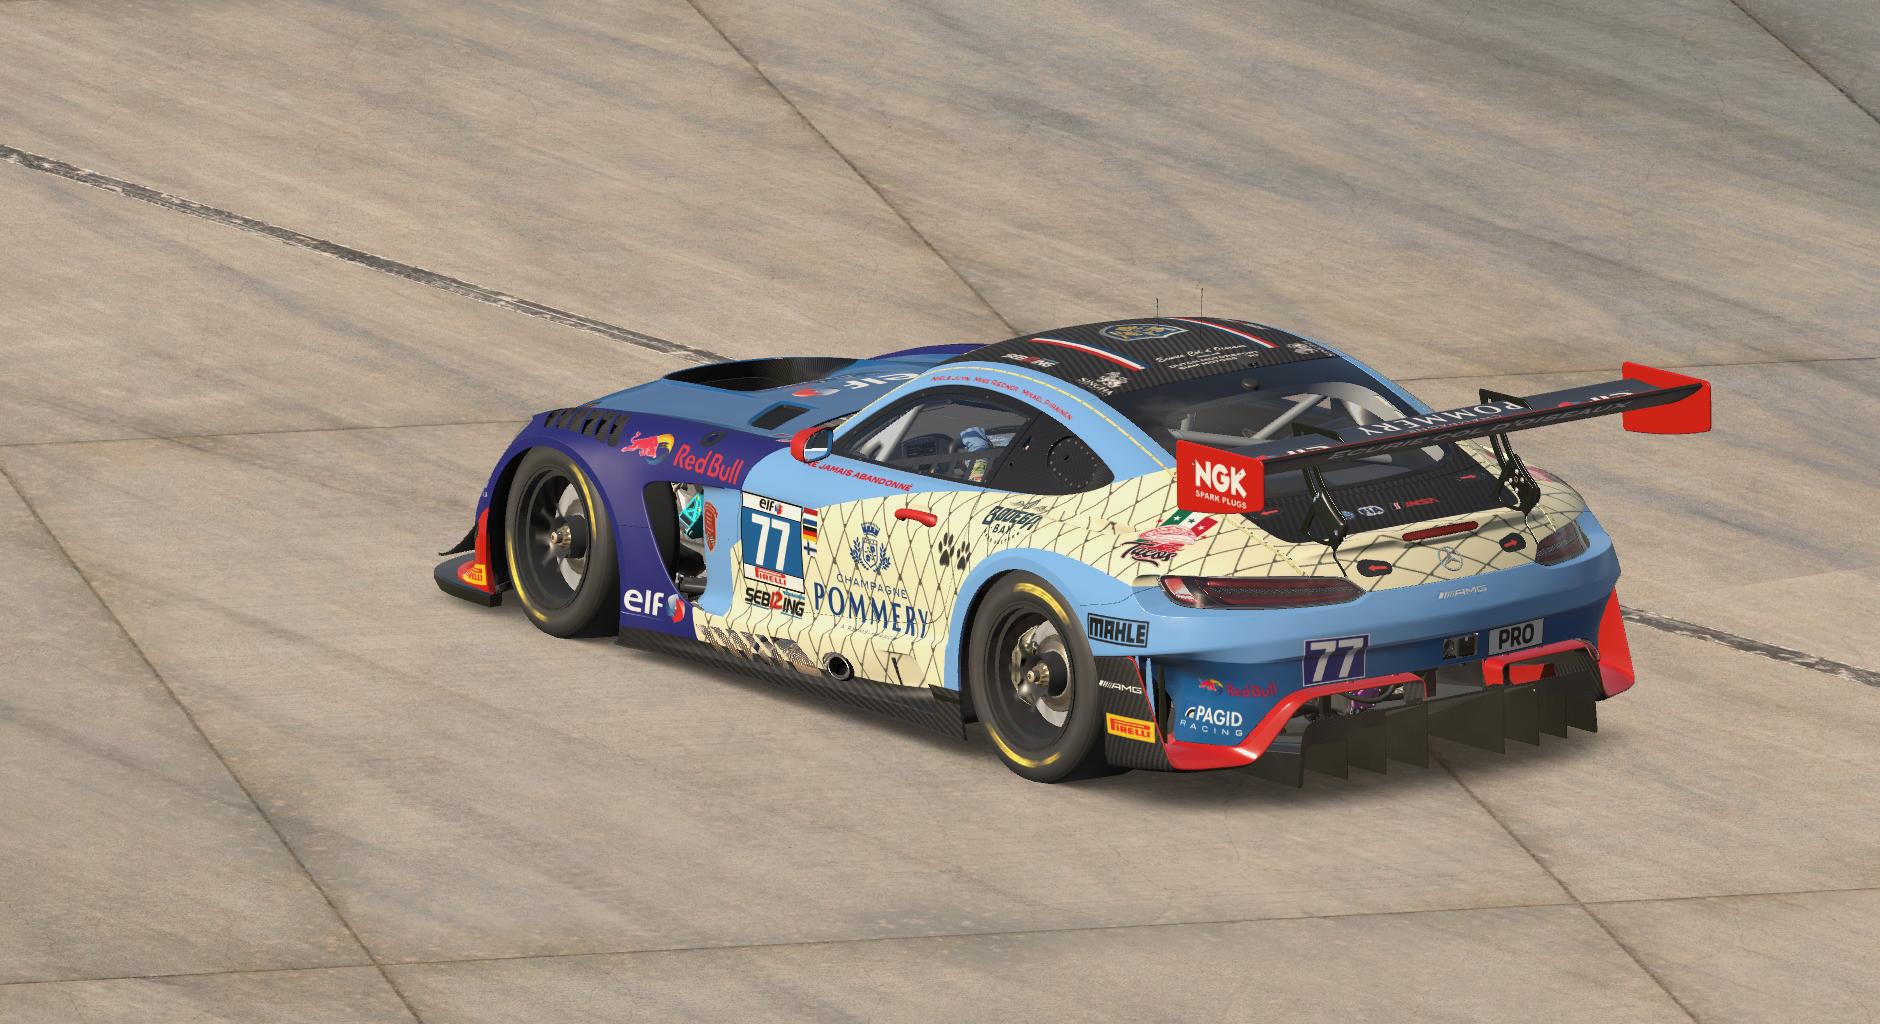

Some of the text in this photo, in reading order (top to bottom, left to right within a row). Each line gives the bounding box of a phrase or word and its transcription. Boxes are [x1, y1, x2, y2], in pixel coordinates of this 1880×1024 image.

[1358, 400, 1524, 436] POMMERY
[818, 464, 853, 477] JAMAIS
[854, 471, 912, 492] ABANDONNÉ
[1194, 459, 1247, 499] NGK
[759, 498, 775, 511] elf
[1195, 489, 1247, 510] SPARK PLUGS
[992, 523, 1015, 534] BAY
[751, 513, 791, 571] 77
[1121, 541, 1178, 566] Tacos
[755, 567, 787, 586] PIRELLI
[836, 573, 908, 600] CHAMPAGNE
[623, 588, 664, 616] elf
[1452, 584, 1488, 597] AMG
[813, 582, 928, 638] POMMERY
[1089, 617, 1146, 645] MAHLE
[1499, 623, 1535, 649] PRO
[1310, 637, 1365, 682] 77
[1110, 682, 1142, 695] AMG
[1110, 717, 1151, 739] PIRELLI
[1180, 719, 1243, 737] RACING
[1196, 705, 1243, 727] PAGID
